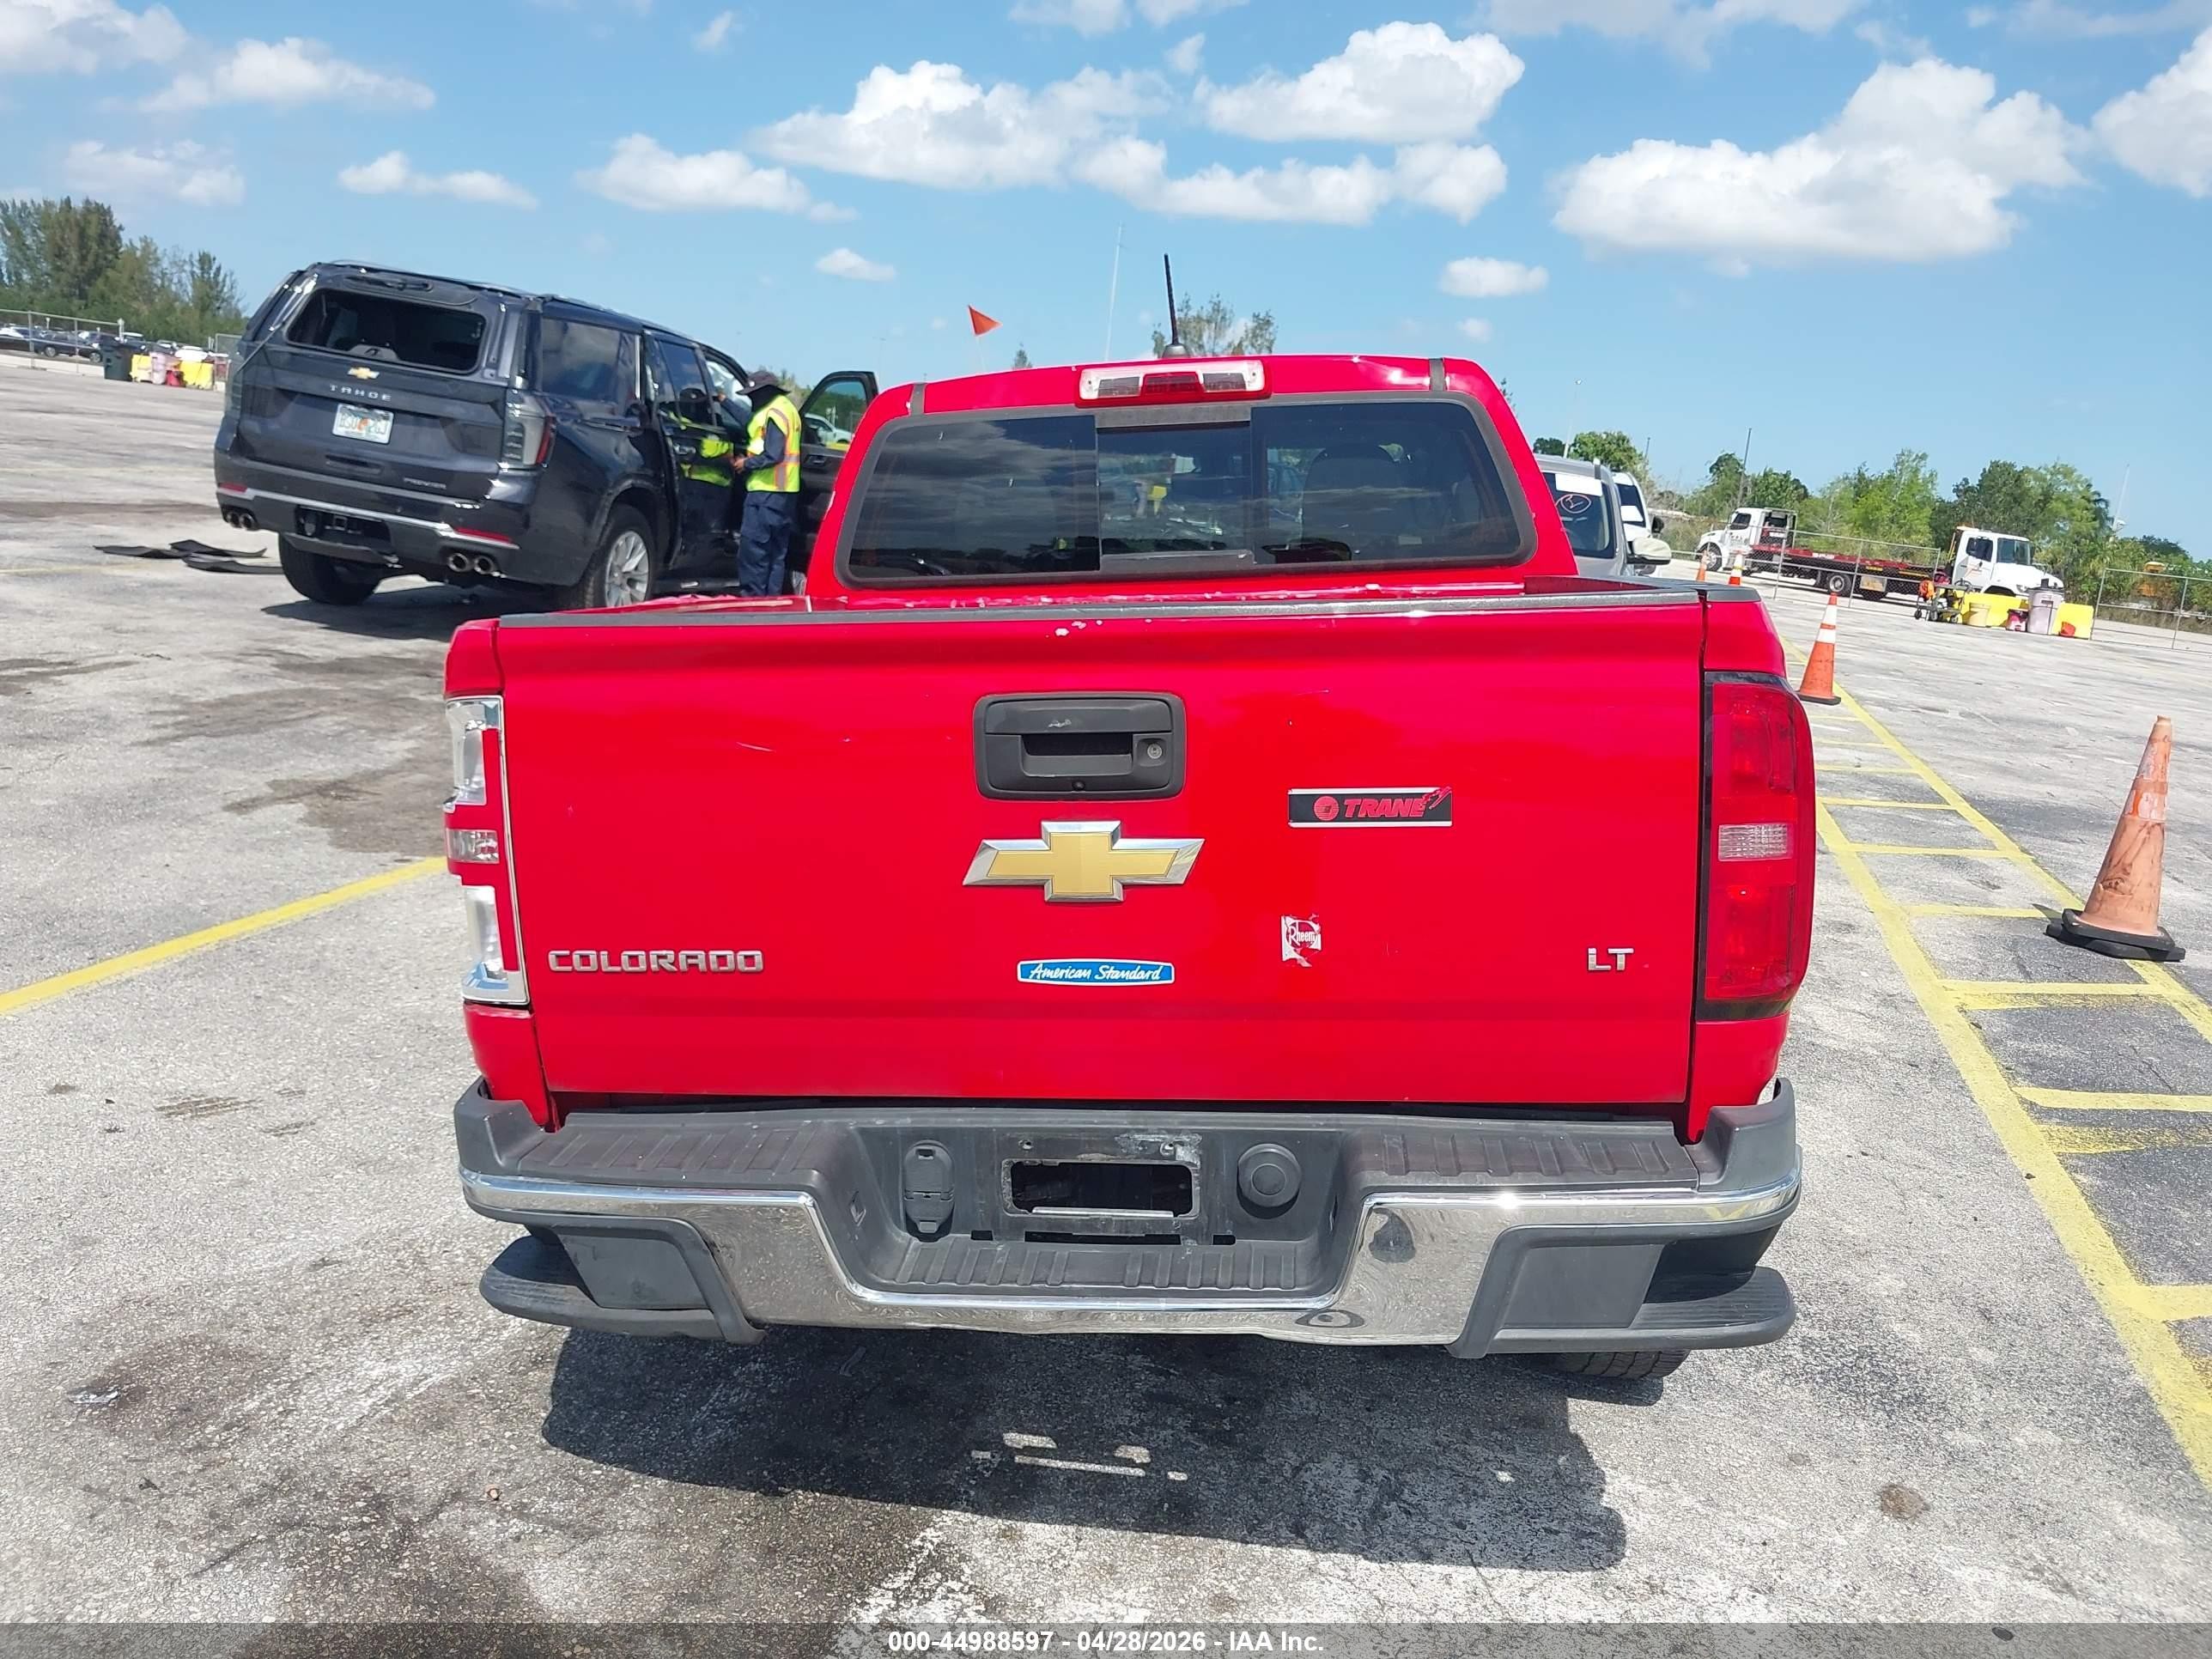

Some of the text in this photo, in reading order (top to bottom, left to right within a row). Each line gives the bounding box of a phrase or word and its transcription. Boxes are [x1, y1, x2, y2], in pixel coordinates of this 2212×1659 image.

[329, 384, 392, 402] TAHOE
[1343, 798, 1426, 818] TRANE
[1288, 921, 1316, 946] Rheem
[548, 950, 764, 973] COLORADO
[1587, 948, 1634, 971] LT
[1029, 963, 1164, 981] American Standard
